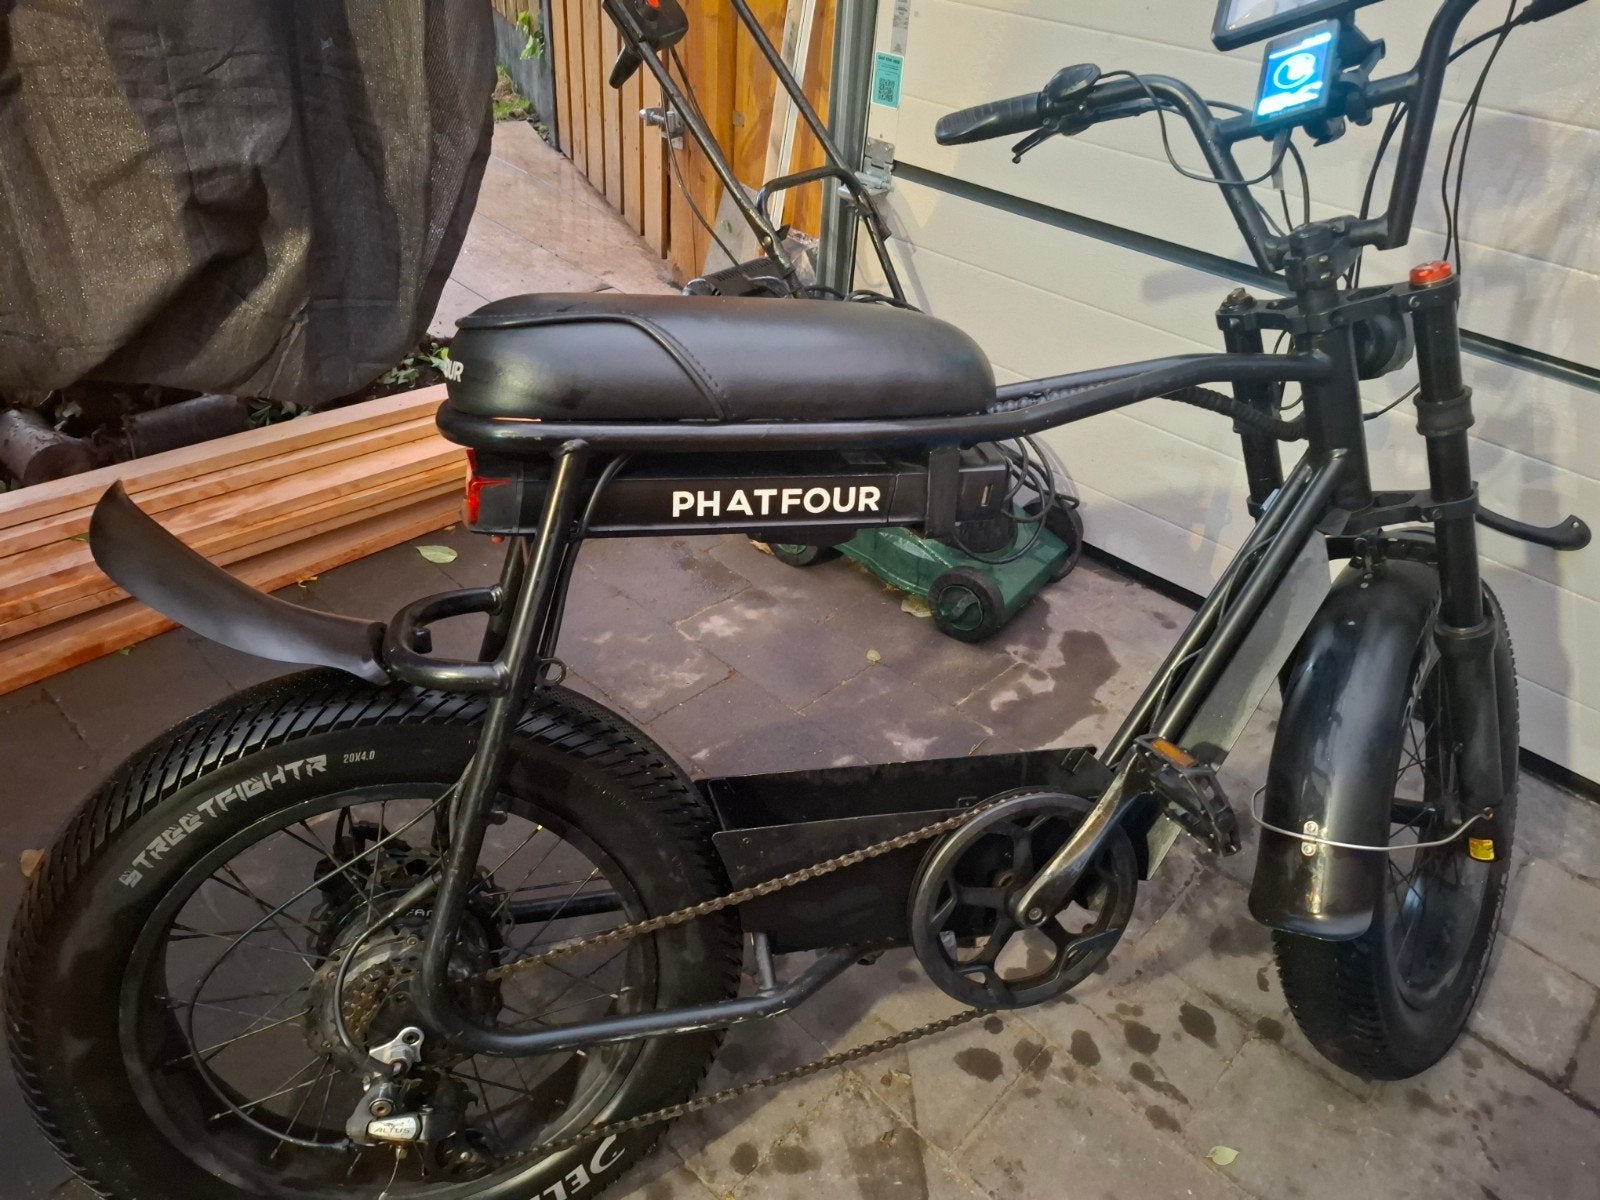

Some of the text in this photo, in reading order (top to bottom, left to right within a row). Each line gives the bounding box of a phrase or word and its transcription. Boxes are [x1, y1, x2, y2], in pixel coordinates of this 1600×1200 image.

[672, 486, 881, 517] PHATFOUR
[343, 750, 376, 764] 20X4.0
[119, 755, 327, 888] STREETFIGHTR
